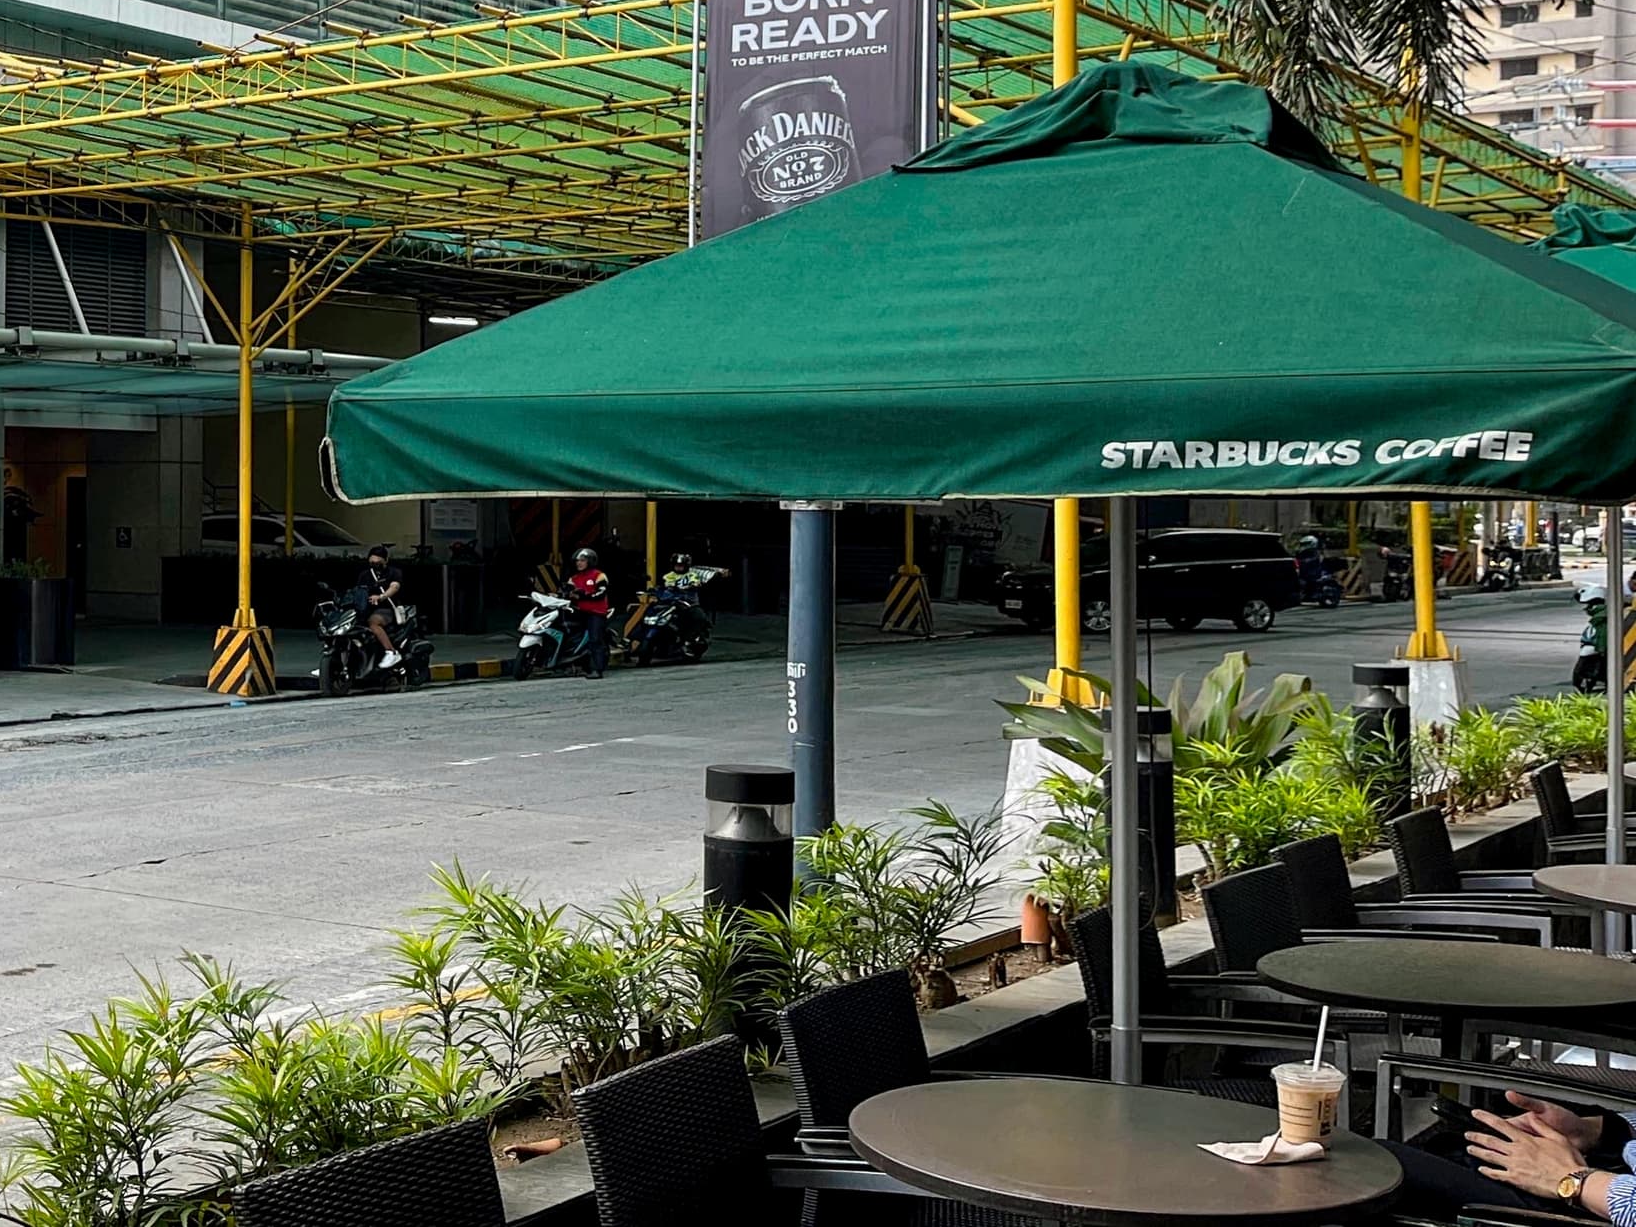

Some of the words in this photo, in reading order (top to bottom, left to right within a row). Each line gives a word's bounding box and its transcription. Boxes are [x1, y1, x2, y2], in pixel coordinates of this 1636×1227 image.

[731, 9, 889, 53] READY
[731, 58, 747, 67] TO
[749, 55, 764, 65] BE
[767, 54, 790, 64] THE
[791, 49, 843, 62] PERFECT
[845, 44, 888, 57] MATCH
[786, 152, 808, 162] OLD
[779, 172, 822, 188] BRAND
[1101, 439, 1362, 469] STARBUCKS
[1375, 431, 1533, 465] COFFEE
